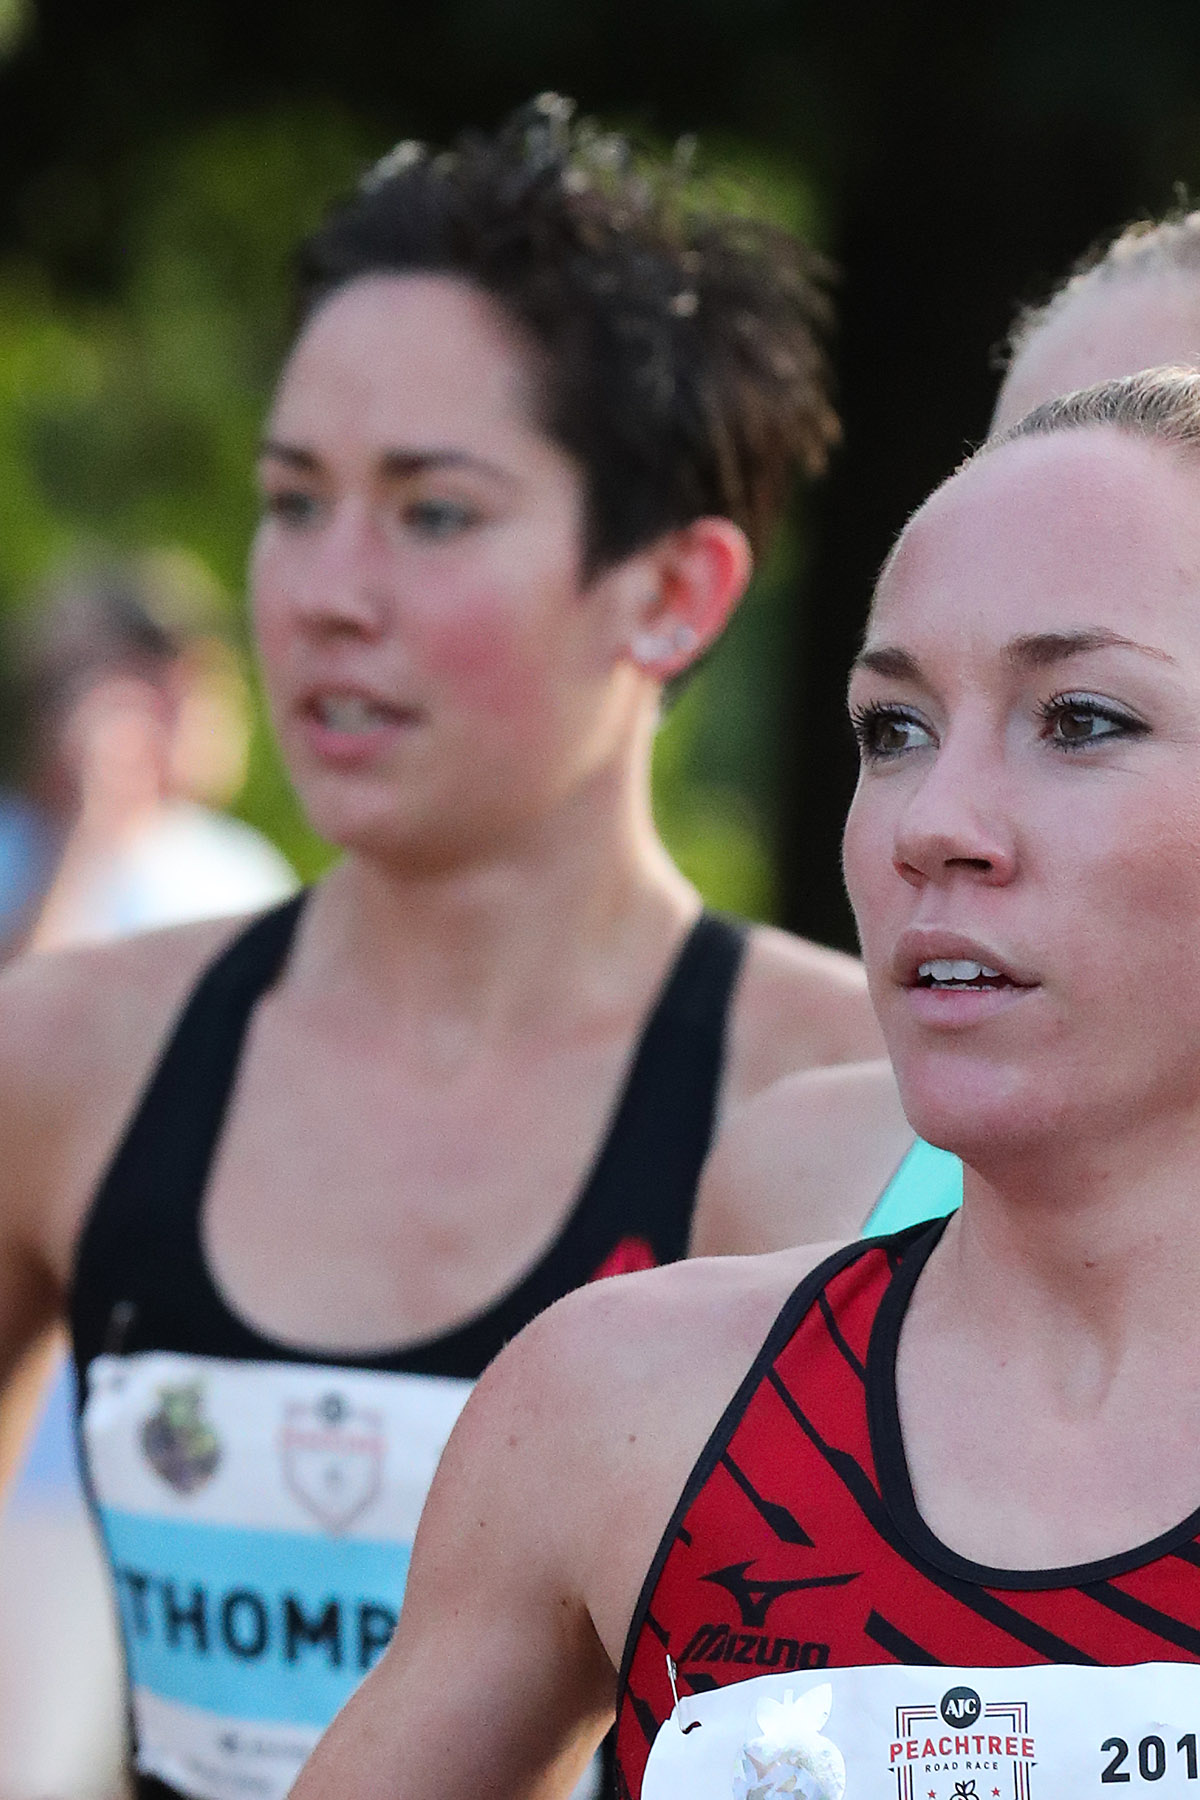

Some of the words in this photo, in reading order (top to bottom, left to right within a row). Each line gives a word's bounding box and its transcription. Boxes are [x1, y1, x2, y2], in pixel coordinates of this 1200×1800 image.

[944, 1698, 977, 1719] AJC
[890, 1736, 1035, 1763] PEACHTREE
[925, 1762, 959, 1773] ROAD
[966, 1761, 999, 1771] RACE
